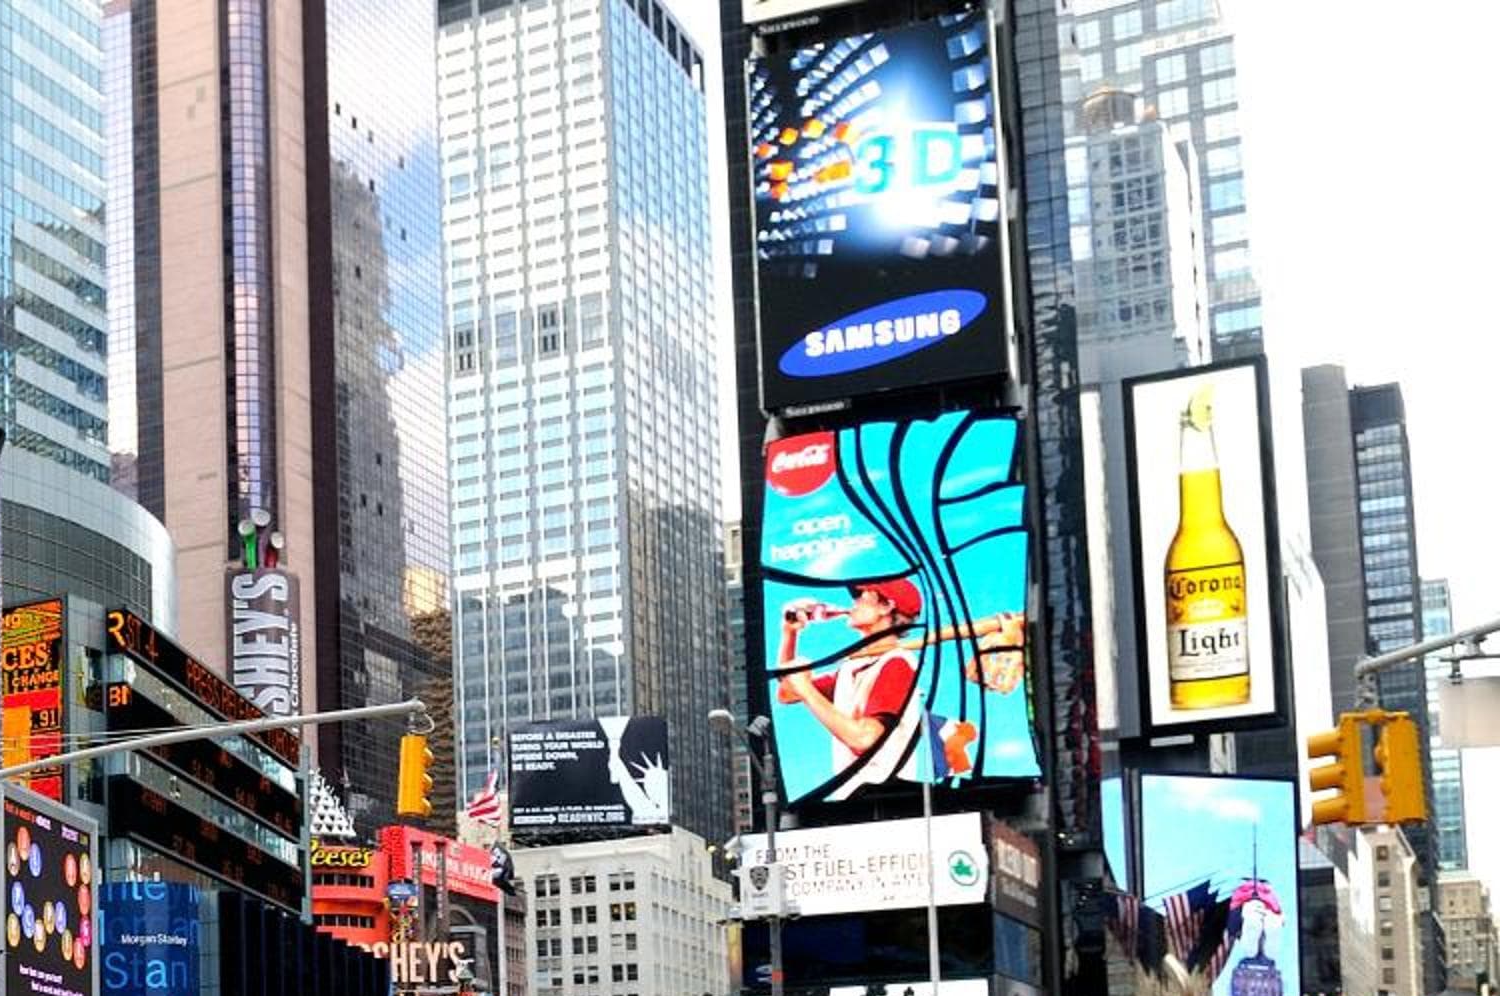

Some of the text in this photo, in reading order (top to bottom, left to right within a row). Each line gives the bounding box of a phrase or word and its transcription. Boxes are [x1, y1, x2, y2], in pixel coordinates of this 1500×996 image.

[854, 128, 963, 194] 3D
[804, 309, 962, 358] SAMSUNG
[791, 513, 851, 537] open
[771, 530, 878, 564] happiness
[1169, 576, 1241, 600] Corona
[232, 573, 289, 718] SHEY'S
[1179, 627, 1240, 657] Light
[804, 844, 831, 860] THE
[814, 853, 931, 878] FUEL-EFFICI
[121, 933, 156, 947] Morgan
